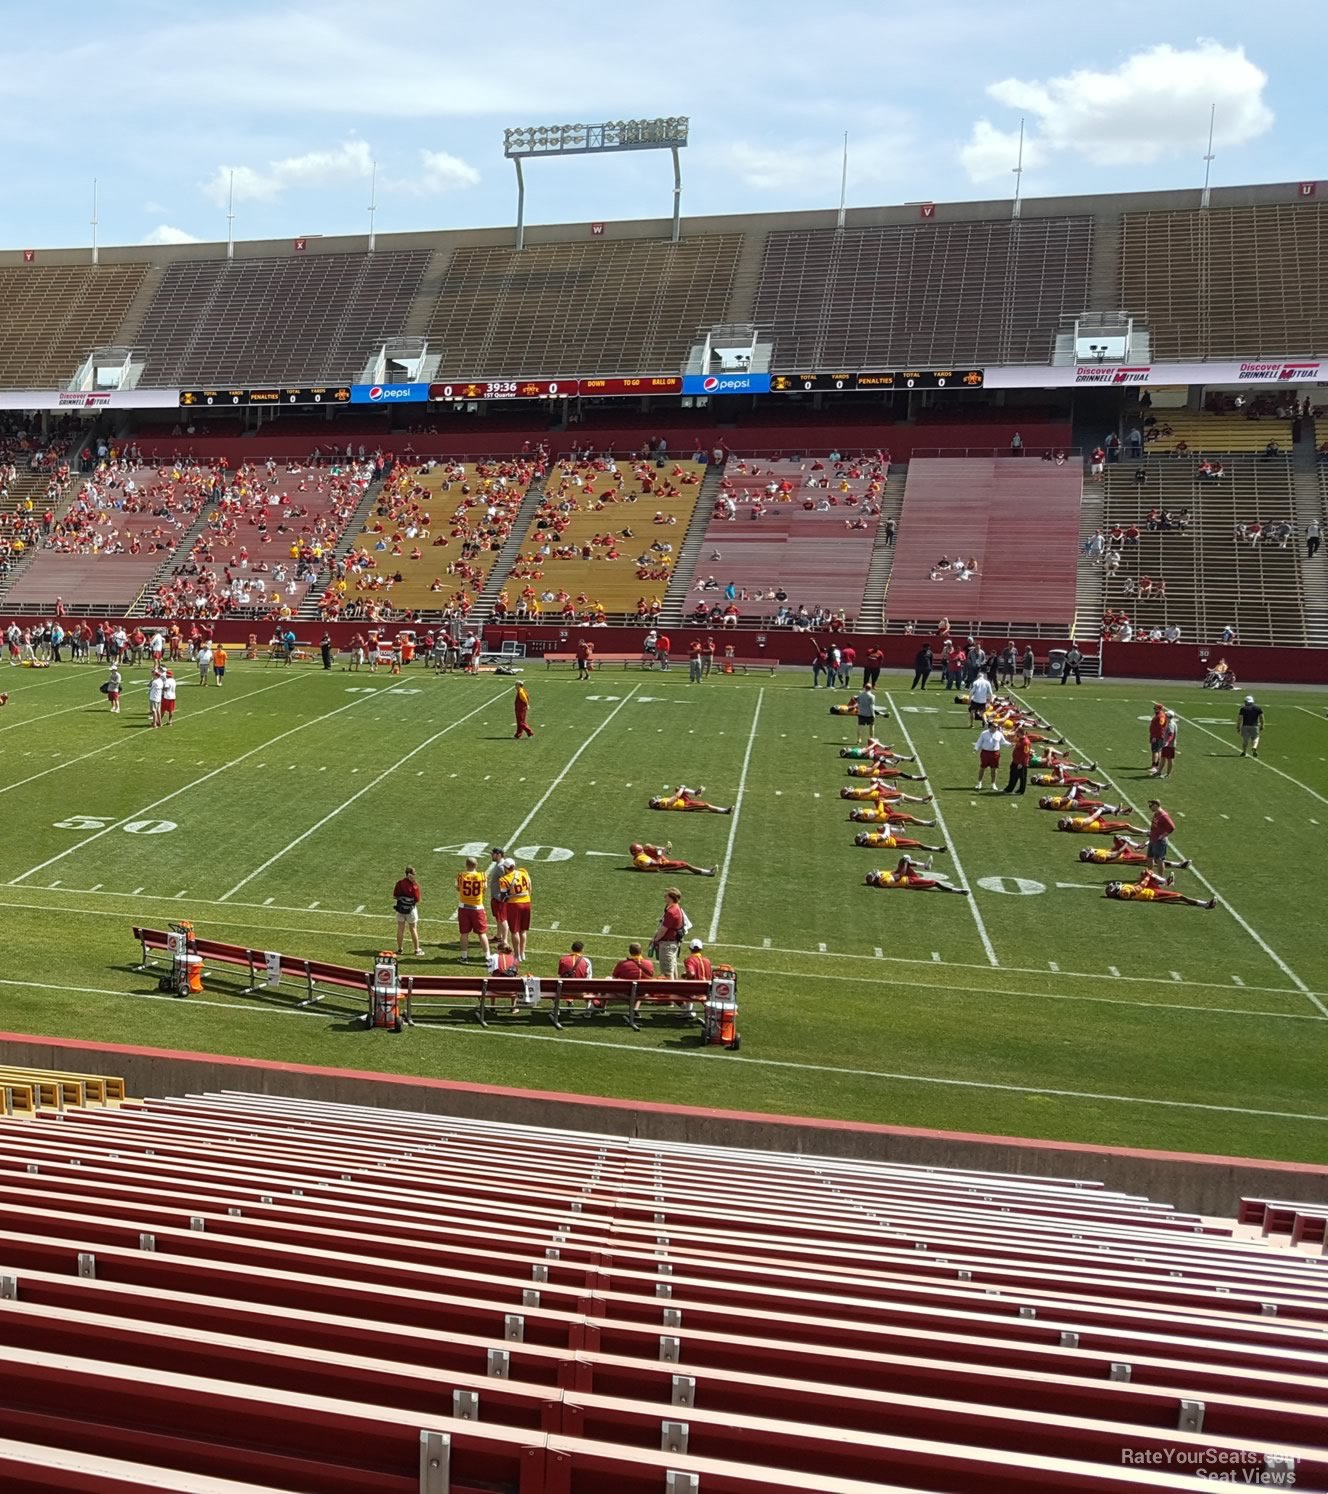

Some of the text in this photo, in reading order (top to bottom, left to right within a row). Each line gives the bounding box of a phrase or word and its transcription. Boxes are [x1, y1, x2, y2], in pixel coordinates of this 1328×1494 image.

[1077, 367, 1115, 375] Discover
[1240, 363, 1281, 371] Discover
[1076, 372, 1151, 384] GRINNELL MUTUAL
[1239, 369, 1319, 380] GRINNELL MUTUAL
[624, 378, 640, 386] TO GO
[652, 378, 665, 386] BALL
[720, 378, 751, 390] pepsi
[804, 381, 812, 390] 0
[836, 380, 843, 389] 0
[858, 377, 893, 385] PENALTIES
[907, 379, 914, 387] 0
[938, 378, 945, 387] 0
[444, 386, 452, 396] 0
[486, 382, 517, 393] 39:36
[549, 383, 558, 394] 0
[250, 393, 279, 401] PENALTIES
[315, 394, 321, 402] 0
[384, 388, 410, 399] pepsi
[207, 397, 213, 405] 0
[232, 396, 239, 404] 0
[290, 395, 296, 403] 0
[52, 815, 178, 834] 50
[433, 841, 575, 862] 40
[462, 880, 481, 897] 58
